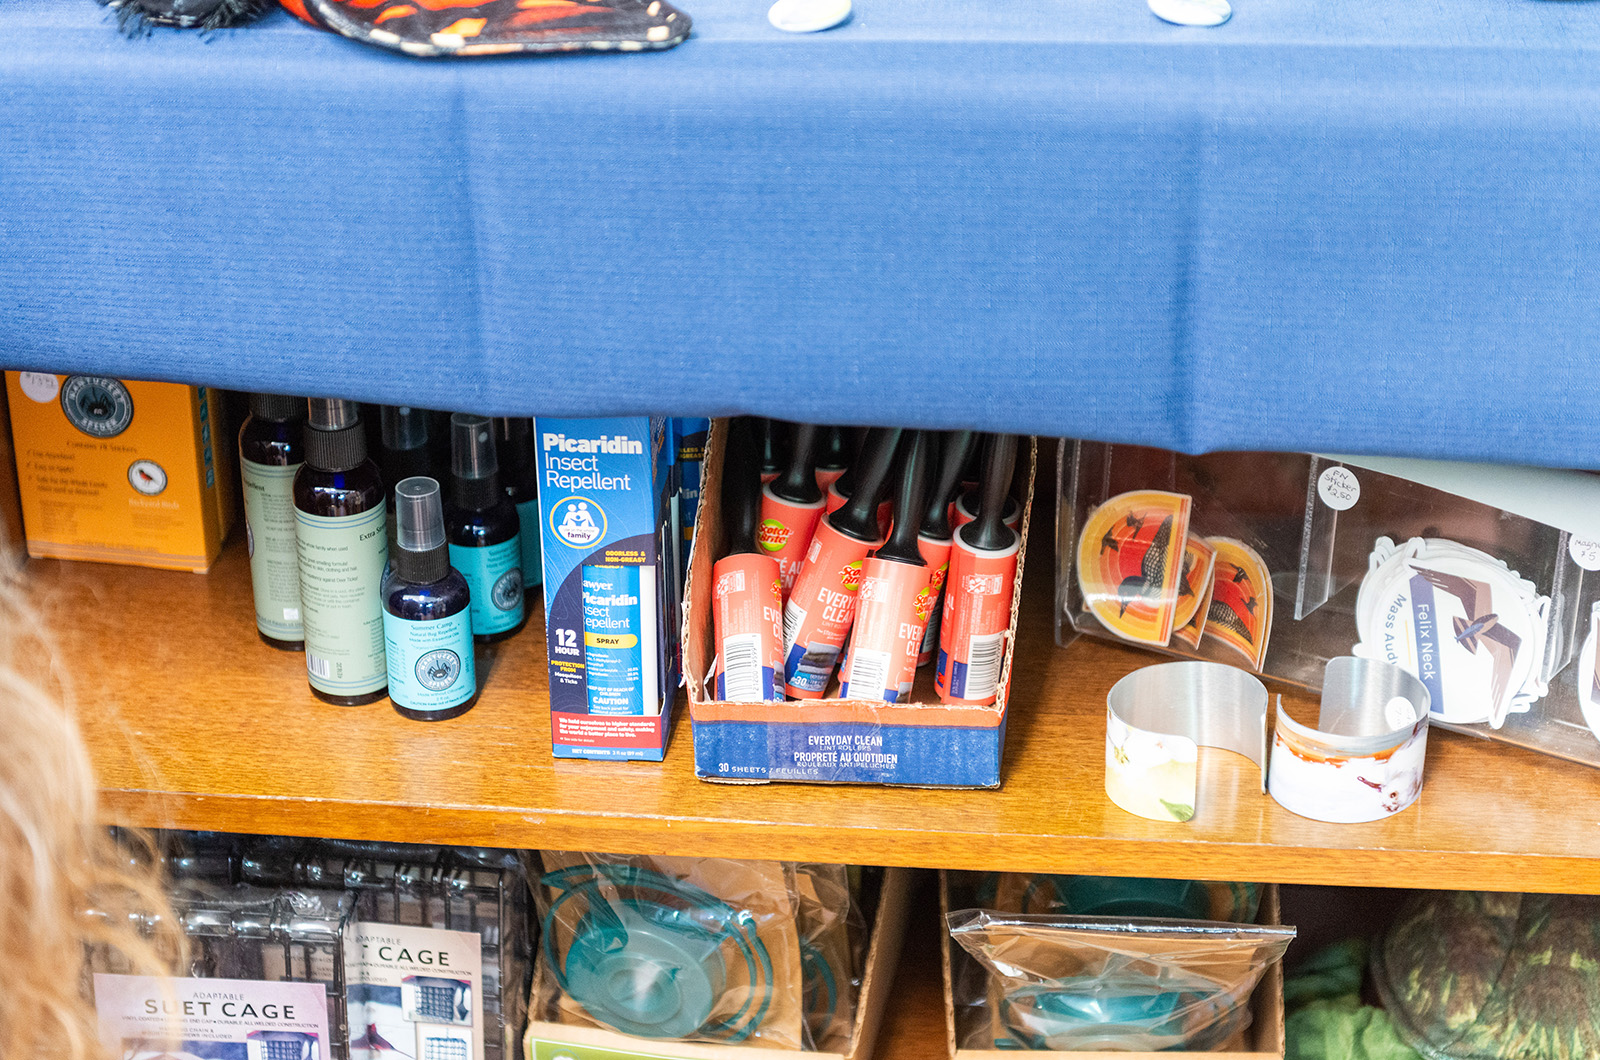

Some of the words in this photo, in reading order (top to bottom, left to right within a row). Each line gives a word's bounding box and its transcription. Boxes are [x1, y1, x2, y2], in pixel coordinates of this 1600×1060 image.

[542, 433, 643, 455] Picaridin
[545, 452, 599, 472] Insect
[546, 470, 631, 492] Repellent
[360, 530, 376, 542] Extra
[567, 532, 592, 540] family
[583, 580, 613, 591] awyer
[583, 592, 638, 606] icaridin
[1385, 594, 1406, 630] Mass
[585, 617, 630, 629] epellent
[1418, 604, 1432, 638] Felix
[556, 629, 577, 648] 12
[555, 646, 580, 656] HOUR
[1384, 633, 1398, 664] Aud
[551, 660, 585, 669] PROTECTION
[1422, 643, 1436, 680] Neck
[428, 676, 452, 687] SPIDER
[794, 676, 807, 687] 30
[592, 696, 628, 705] CAUTION
[808, 736, 852, 746] EVERYDAY
[854, 736, 883, 747] CLEAN
[794, 751, 838, 762] PROPRETÉ
[840, 754, 851, 762] AU
[854, 753, 898, 764] QUOTIDIEN
[718, 763, 729, 772] 30
[775, 767, 818, 775] FEUILLES
[378, 946, 450, 966] CAGE
[192, 992, 244, 1001] ADAPTABLE
[222, 1002, 296, 1020] CAGE
